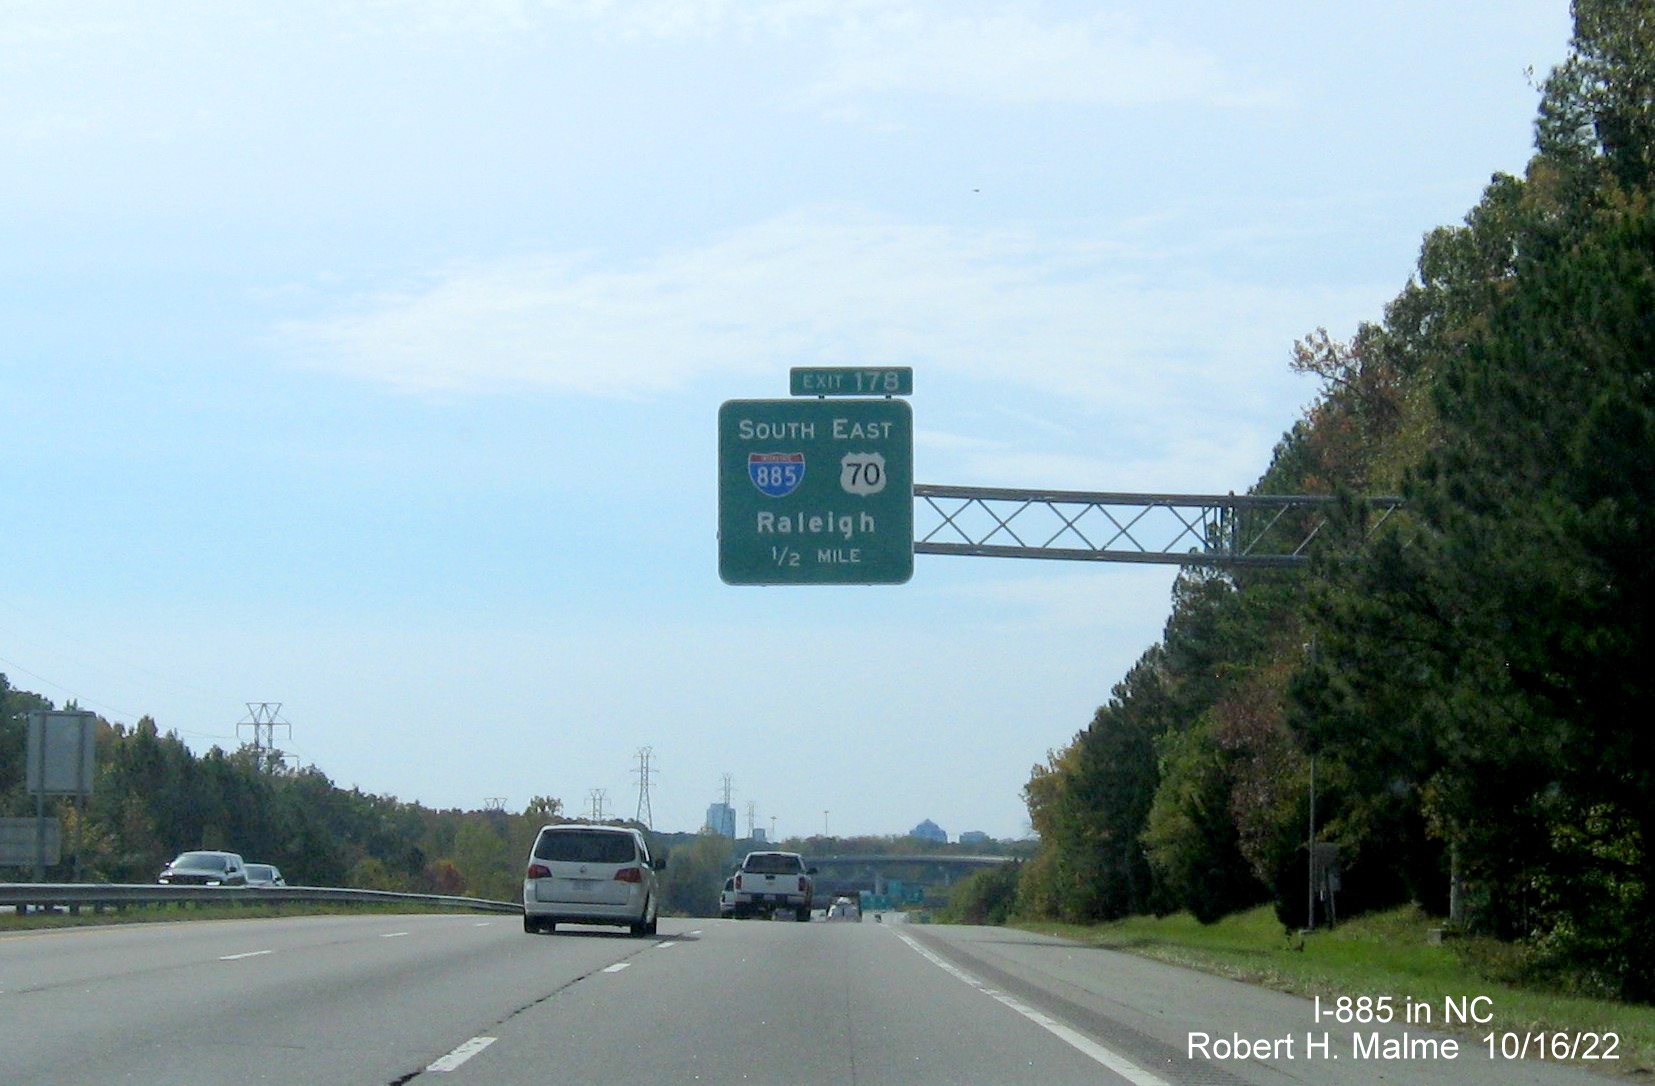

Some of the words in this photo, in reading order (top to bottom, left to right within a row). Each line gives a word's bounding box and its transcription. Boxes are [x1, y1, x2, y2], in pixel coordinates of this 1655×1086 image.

[803, 375, 841, 389] EXIT
[854, 372, 899, 391] 178
[739, 419, 815, 440] SOUTH
[833, 419, 893, 439] EAST
[757, 466, 796, 487] 885
[846, 462, 880, 486] 70
[757, 511, 875, 540] Raleigh
[818, 549, 861, 563] MILE
